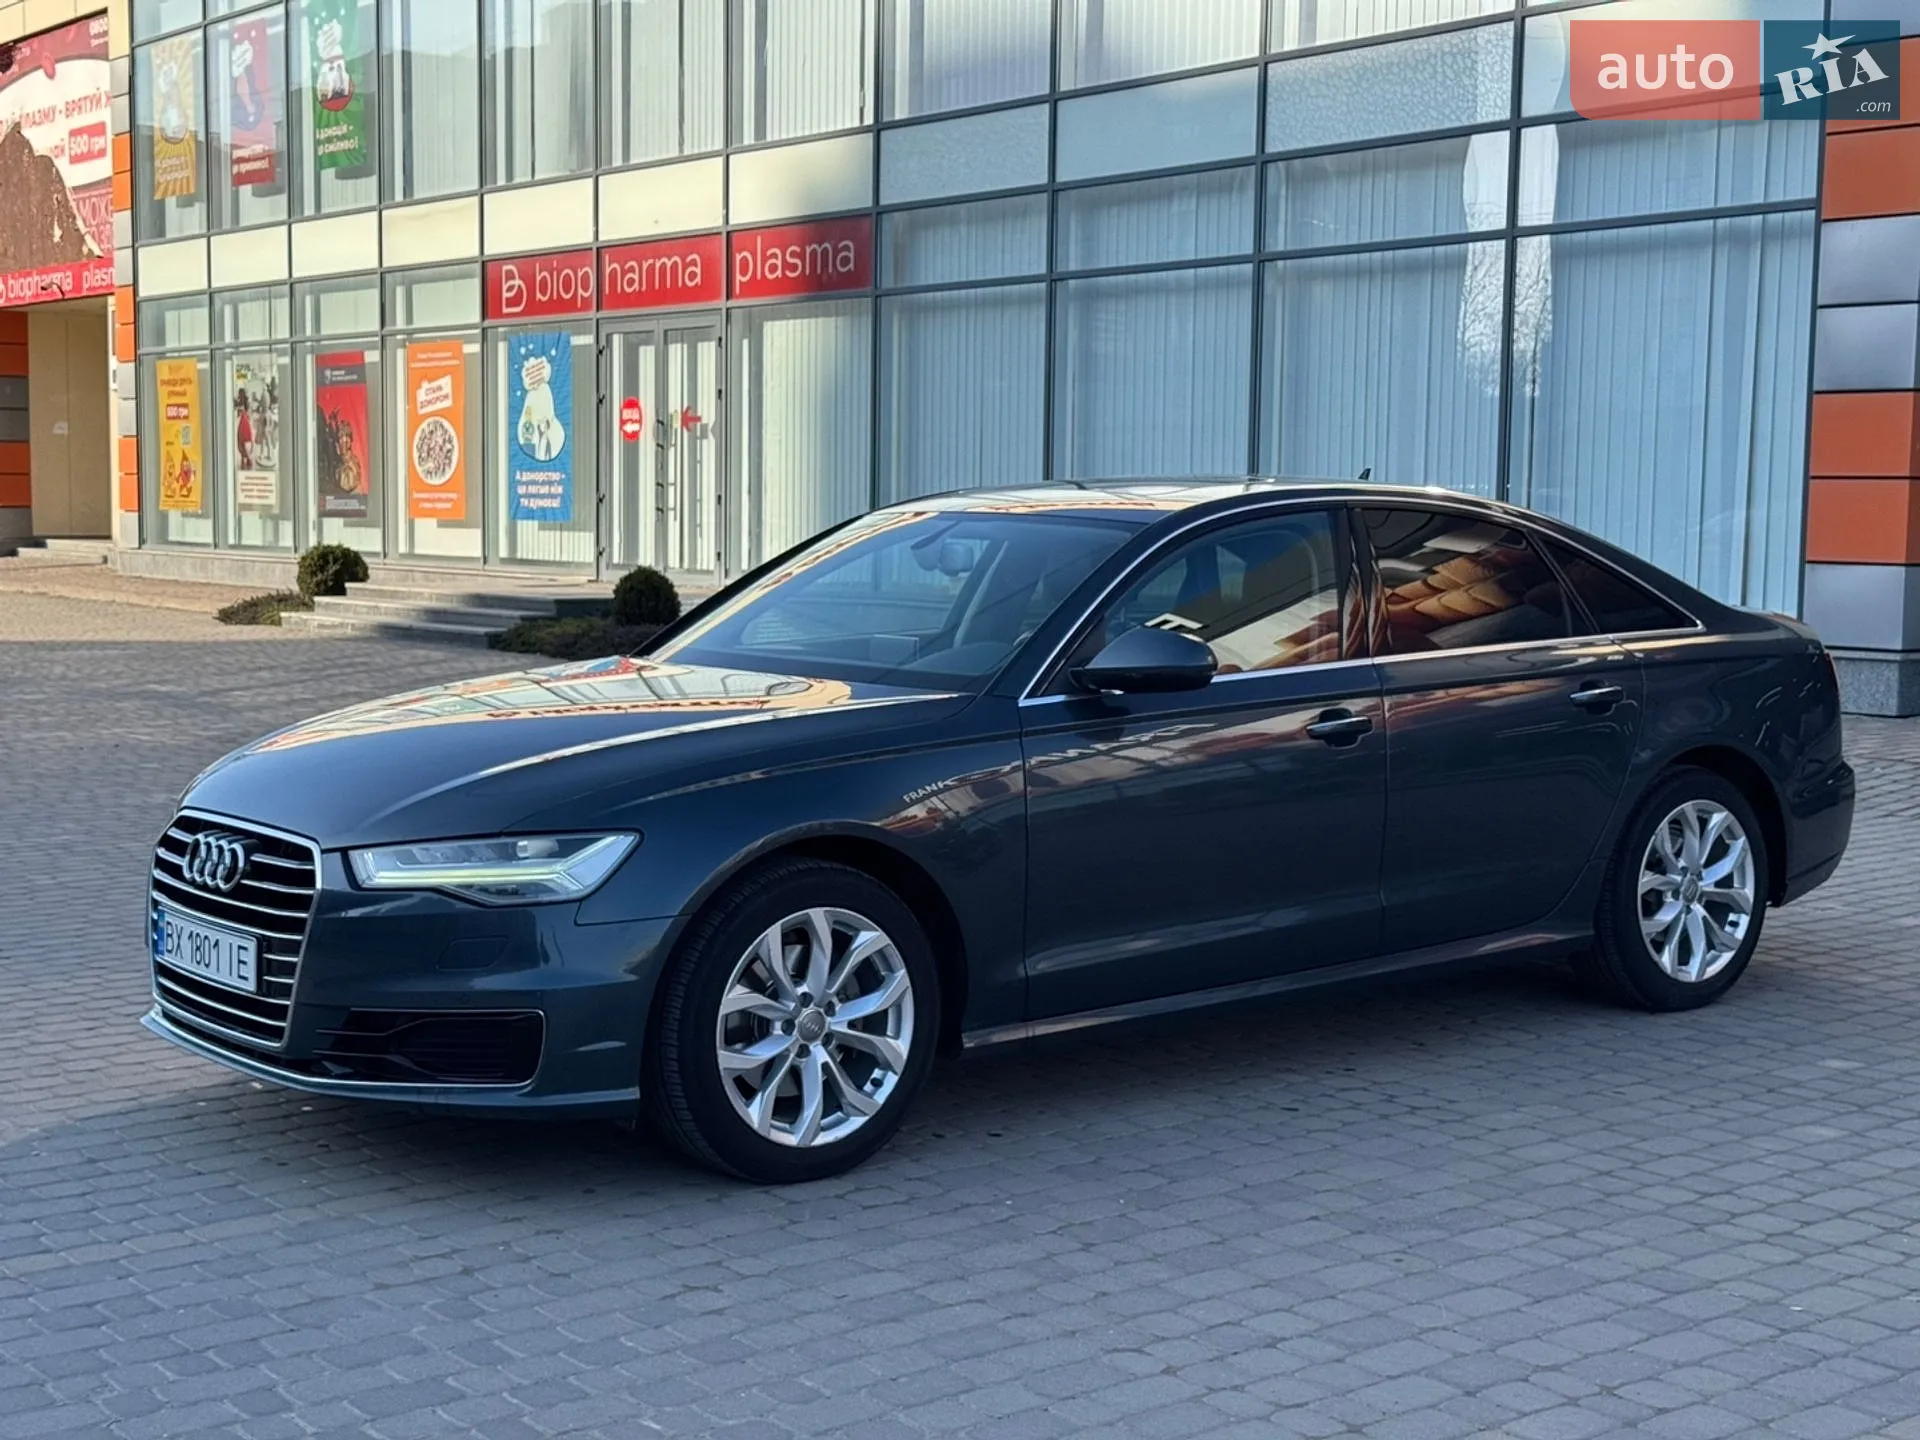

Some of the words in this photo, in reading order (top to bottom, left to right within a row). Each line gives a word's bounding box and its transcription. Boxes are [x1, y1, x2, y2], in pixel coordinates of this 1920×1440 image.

[734, 235, 856, 296] plasma
[165, 920, 184, 960] BX
[187, 930, 220, 974] 1801
[228, 942, 249, 982] IE
